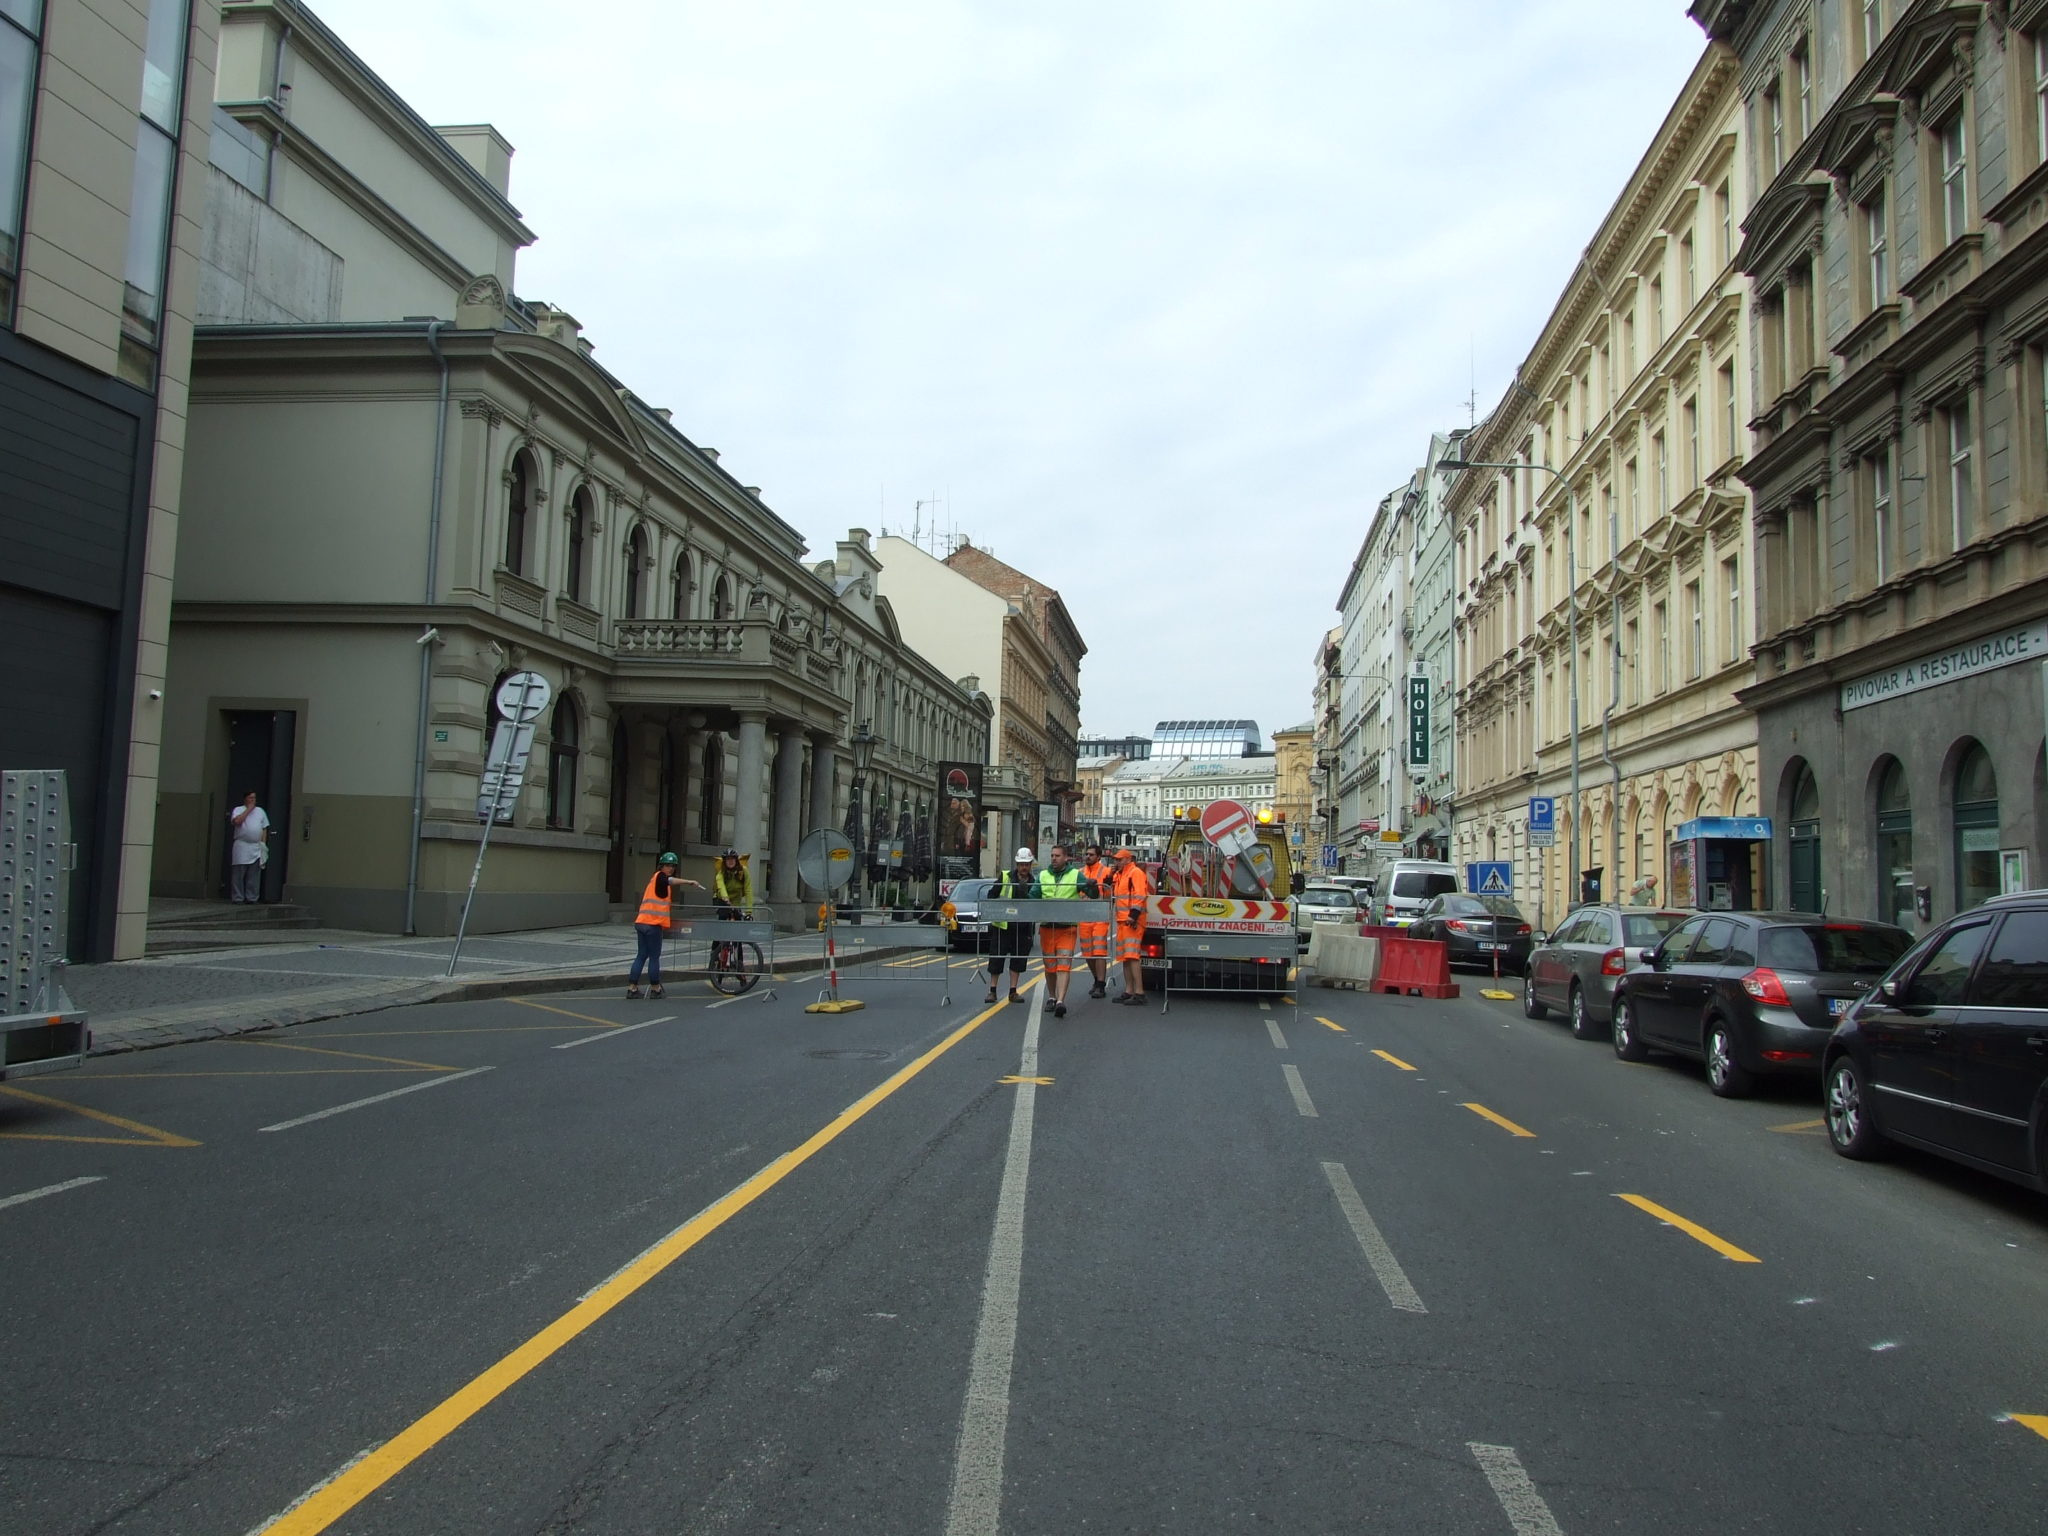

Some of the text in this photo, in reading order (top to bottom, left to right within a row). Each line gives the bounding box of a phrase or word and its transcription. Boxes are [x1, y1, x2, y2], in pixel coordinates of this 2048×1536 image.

[1846, 672, 1900, 703] PIVOVAR
[1904, 670, 1915, 687] A
[1920, 631, 2029, 682] RESTAURACE
[1413, 683, 1425, 758] HOTEL
[1533, 800, 1549, 821] P
